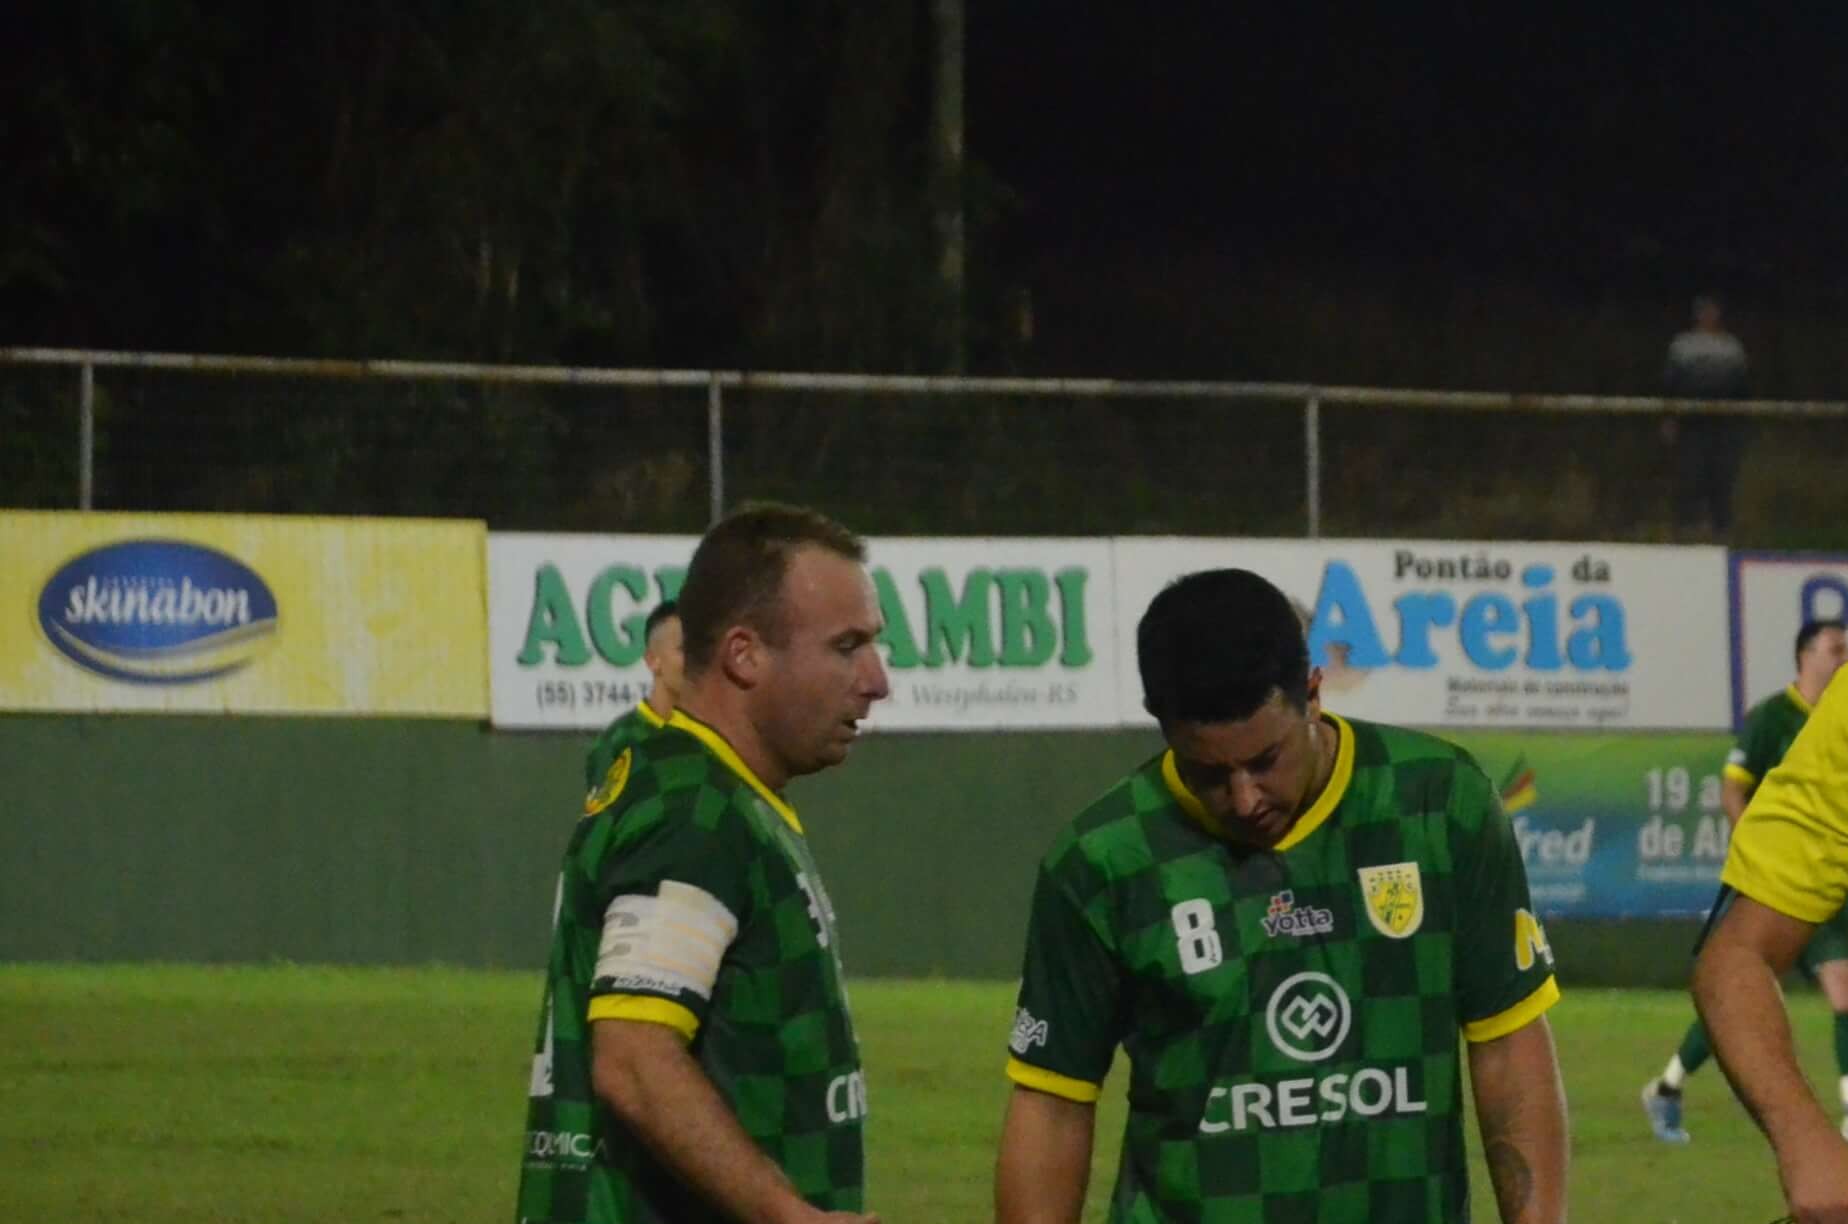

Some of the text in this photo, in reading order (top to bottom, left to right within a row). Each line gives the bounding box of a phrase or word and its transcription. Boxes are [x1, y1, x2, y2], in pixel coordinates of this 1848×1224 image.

[1394, 553, 1611, 583] Pontão da
[65, 576, 251, 626] skinabon
[1308, 561, 1632, 670] Areia
[537, 681, 575, 711] (55)
[1646, 768, 1690, 812] 19
[1638, 816, 1684, 859] de
[1170, 897, 1224, 975] 8
[1264, 906, 1334, 937] yotta
[1199, 1066, 1427, 1135] CRESOL
